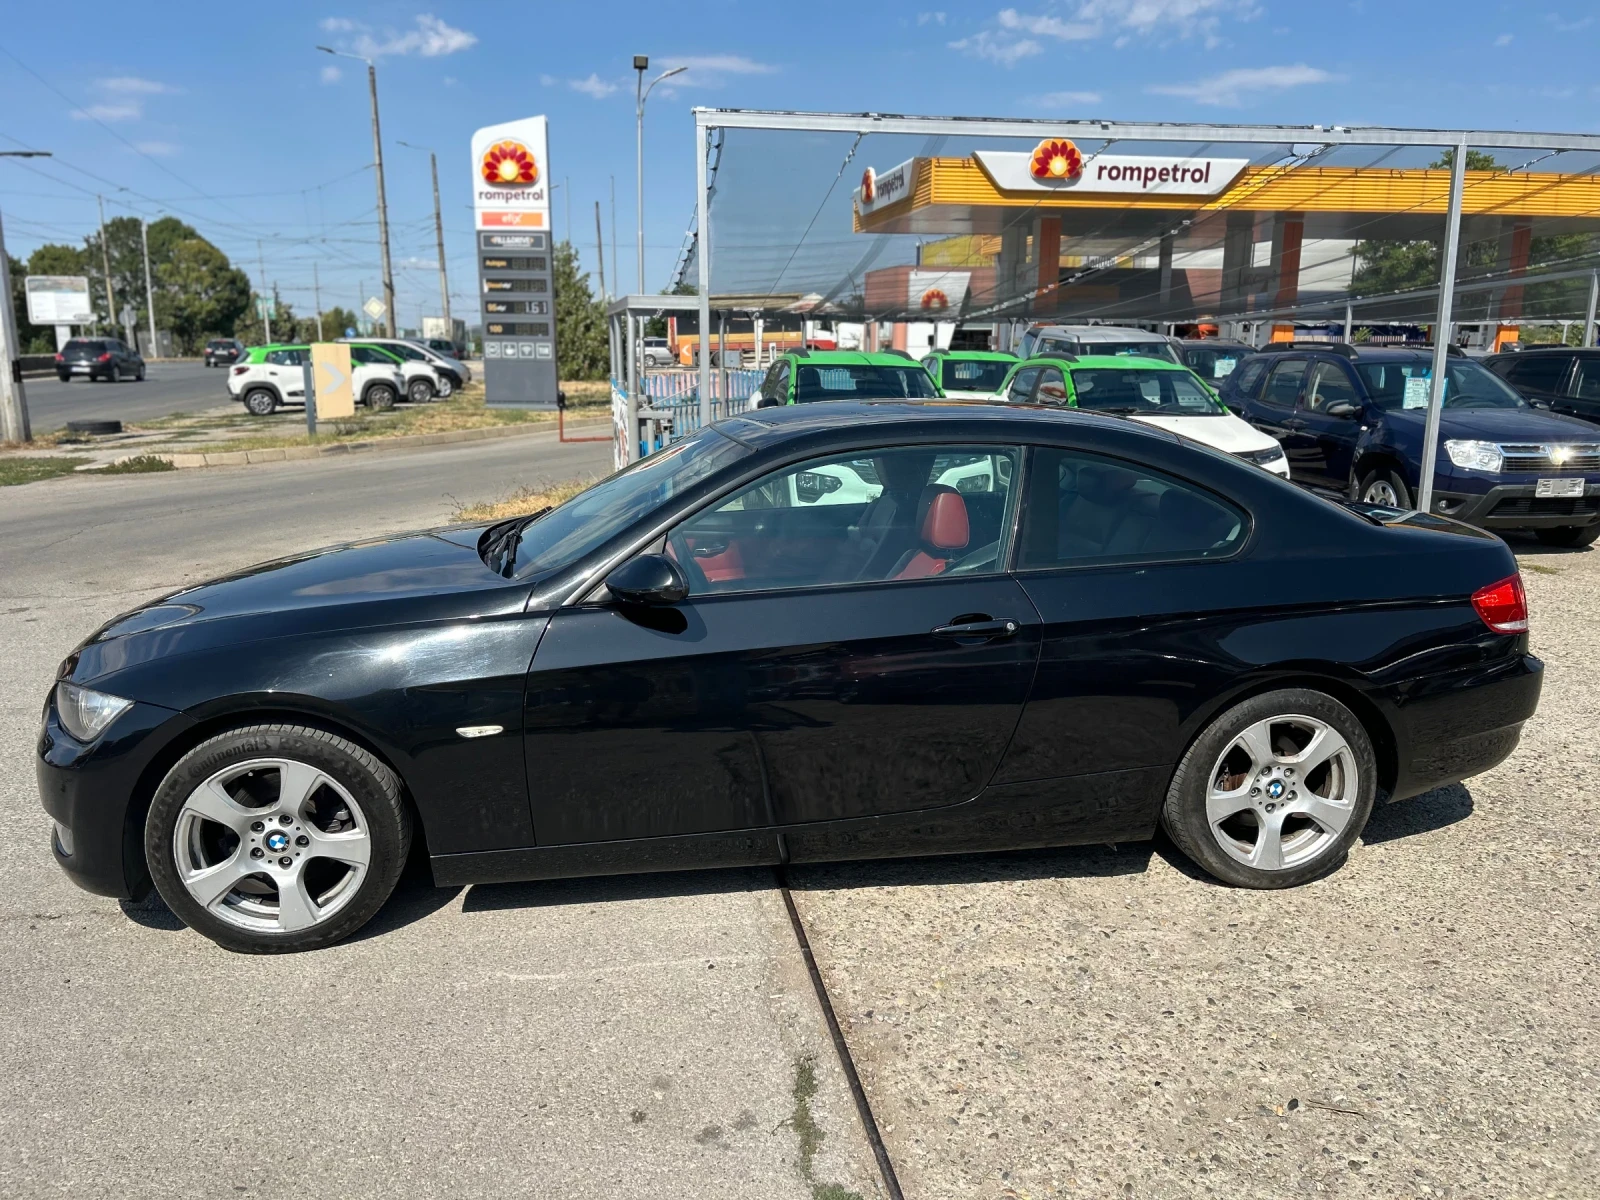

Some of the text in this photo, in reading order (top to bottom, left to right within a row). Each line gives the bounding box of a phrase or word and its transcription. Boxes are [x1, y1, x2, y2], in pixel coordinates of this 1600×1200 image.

[1097, 161, 1211, 189] rompetrol
[478, 188, 544, 204] rompetrol
[188, 740, 259, 778] Continental
